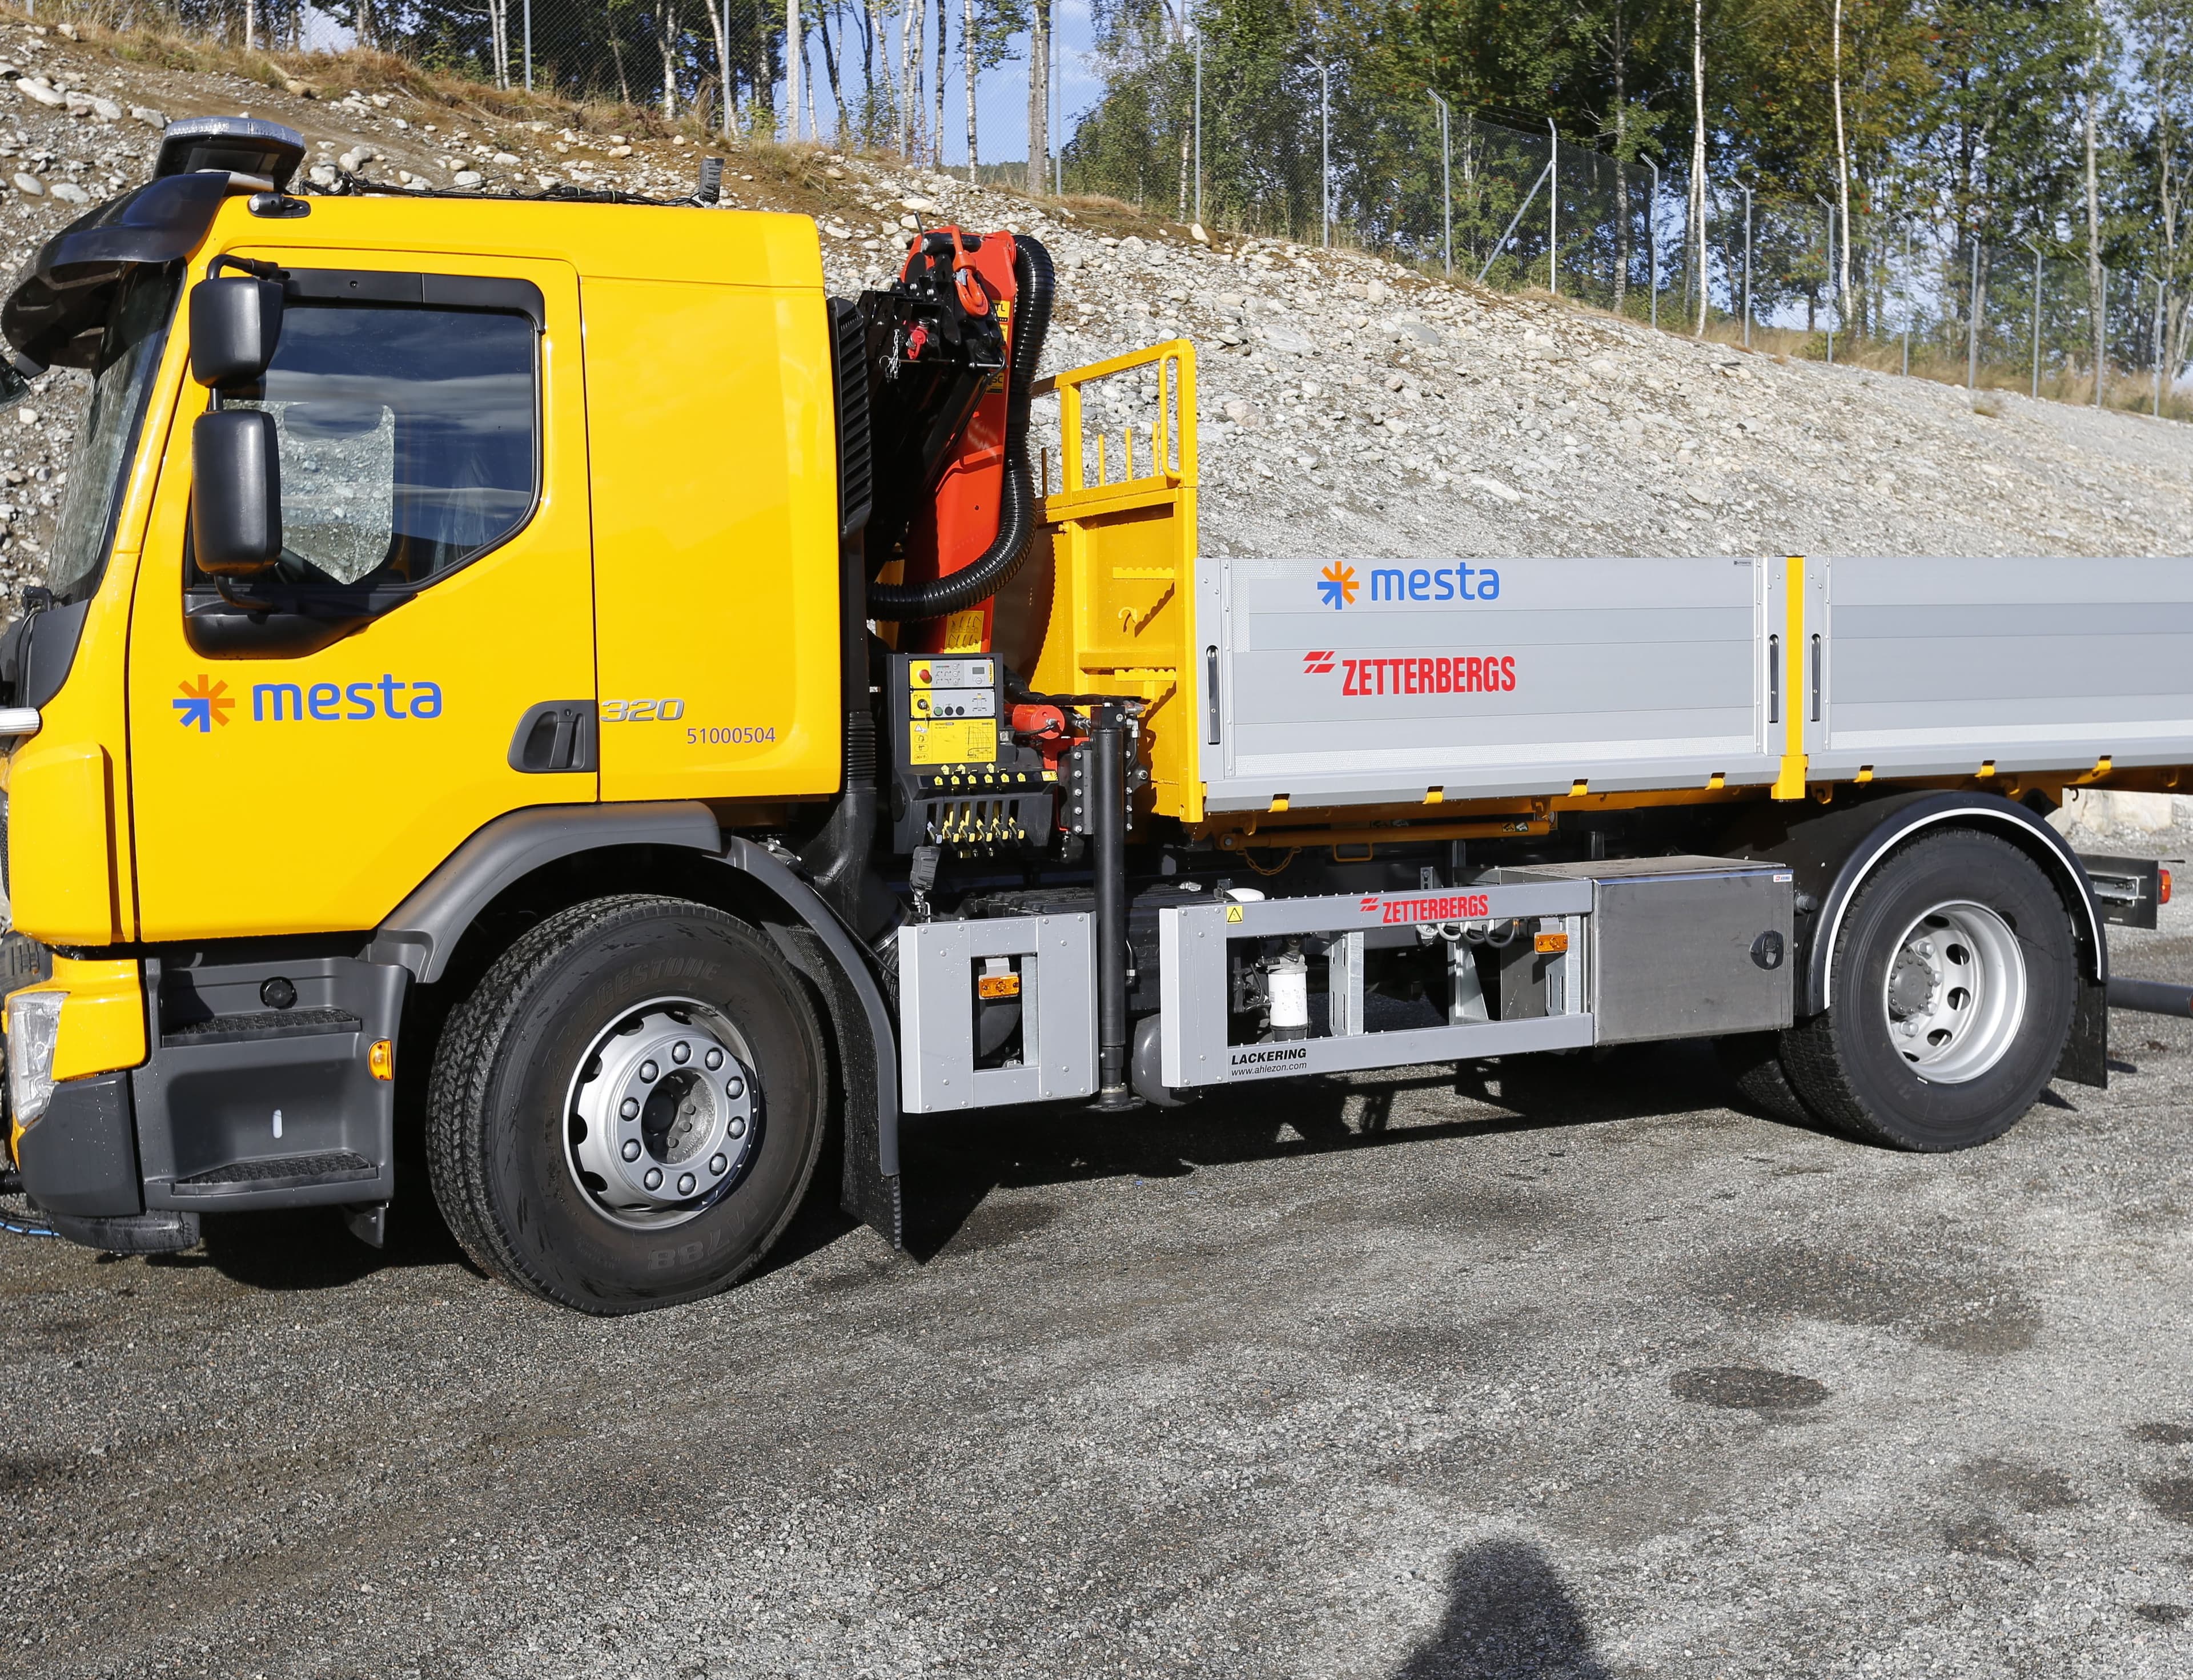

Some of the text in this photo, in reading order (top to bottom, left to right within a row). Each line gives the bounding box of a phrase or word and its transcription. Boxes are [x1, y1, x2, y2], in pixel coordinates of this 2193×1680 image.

[1371, 561, 1500, 601] mesta
[1342, 656, 1516, 696] ZETTERBERGS
[253, 674, 441, 721] mesta
[600, 698, 685, 722] 320
[686, 726, 776, 744] 51000504
[1383, 894, 1489, 924] ZETTERBERGS
[543, 956, 722, 1082] BRIDGESTONE
[1231, 1048, 1307, 1066] LACKERING
[1231, 1062, 1307, 1076] www.ahlezon.com
